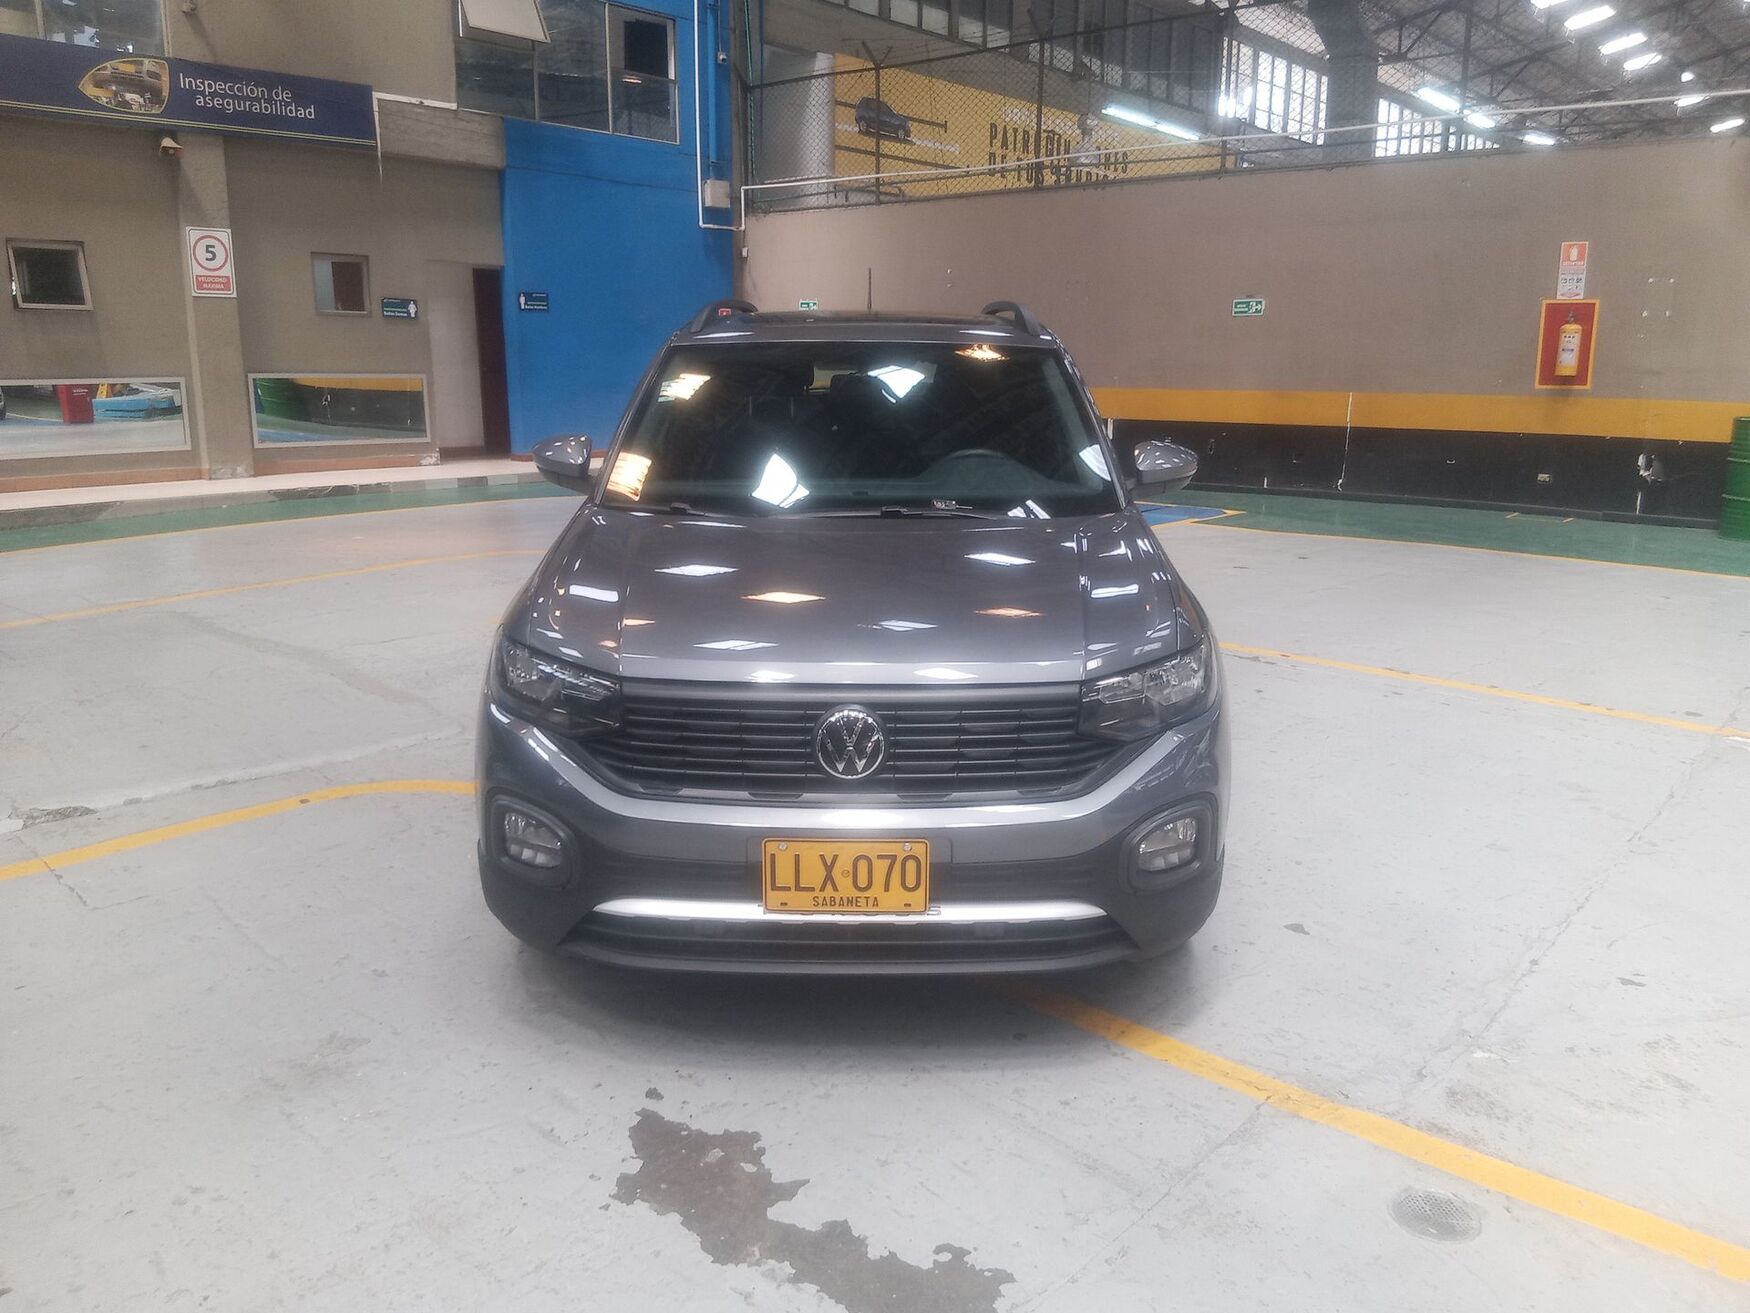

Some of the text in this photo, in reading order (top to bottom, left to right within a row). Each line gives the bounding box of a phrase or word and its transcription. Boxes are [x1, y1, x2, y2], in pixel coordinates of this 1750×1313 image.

[179, 72, 292, 102] Inspección de
[195, 94, 315, 119] asegurabilidad
[205, 244, 217, 262] 5
[812, 896, 880, 908] SABANETA
